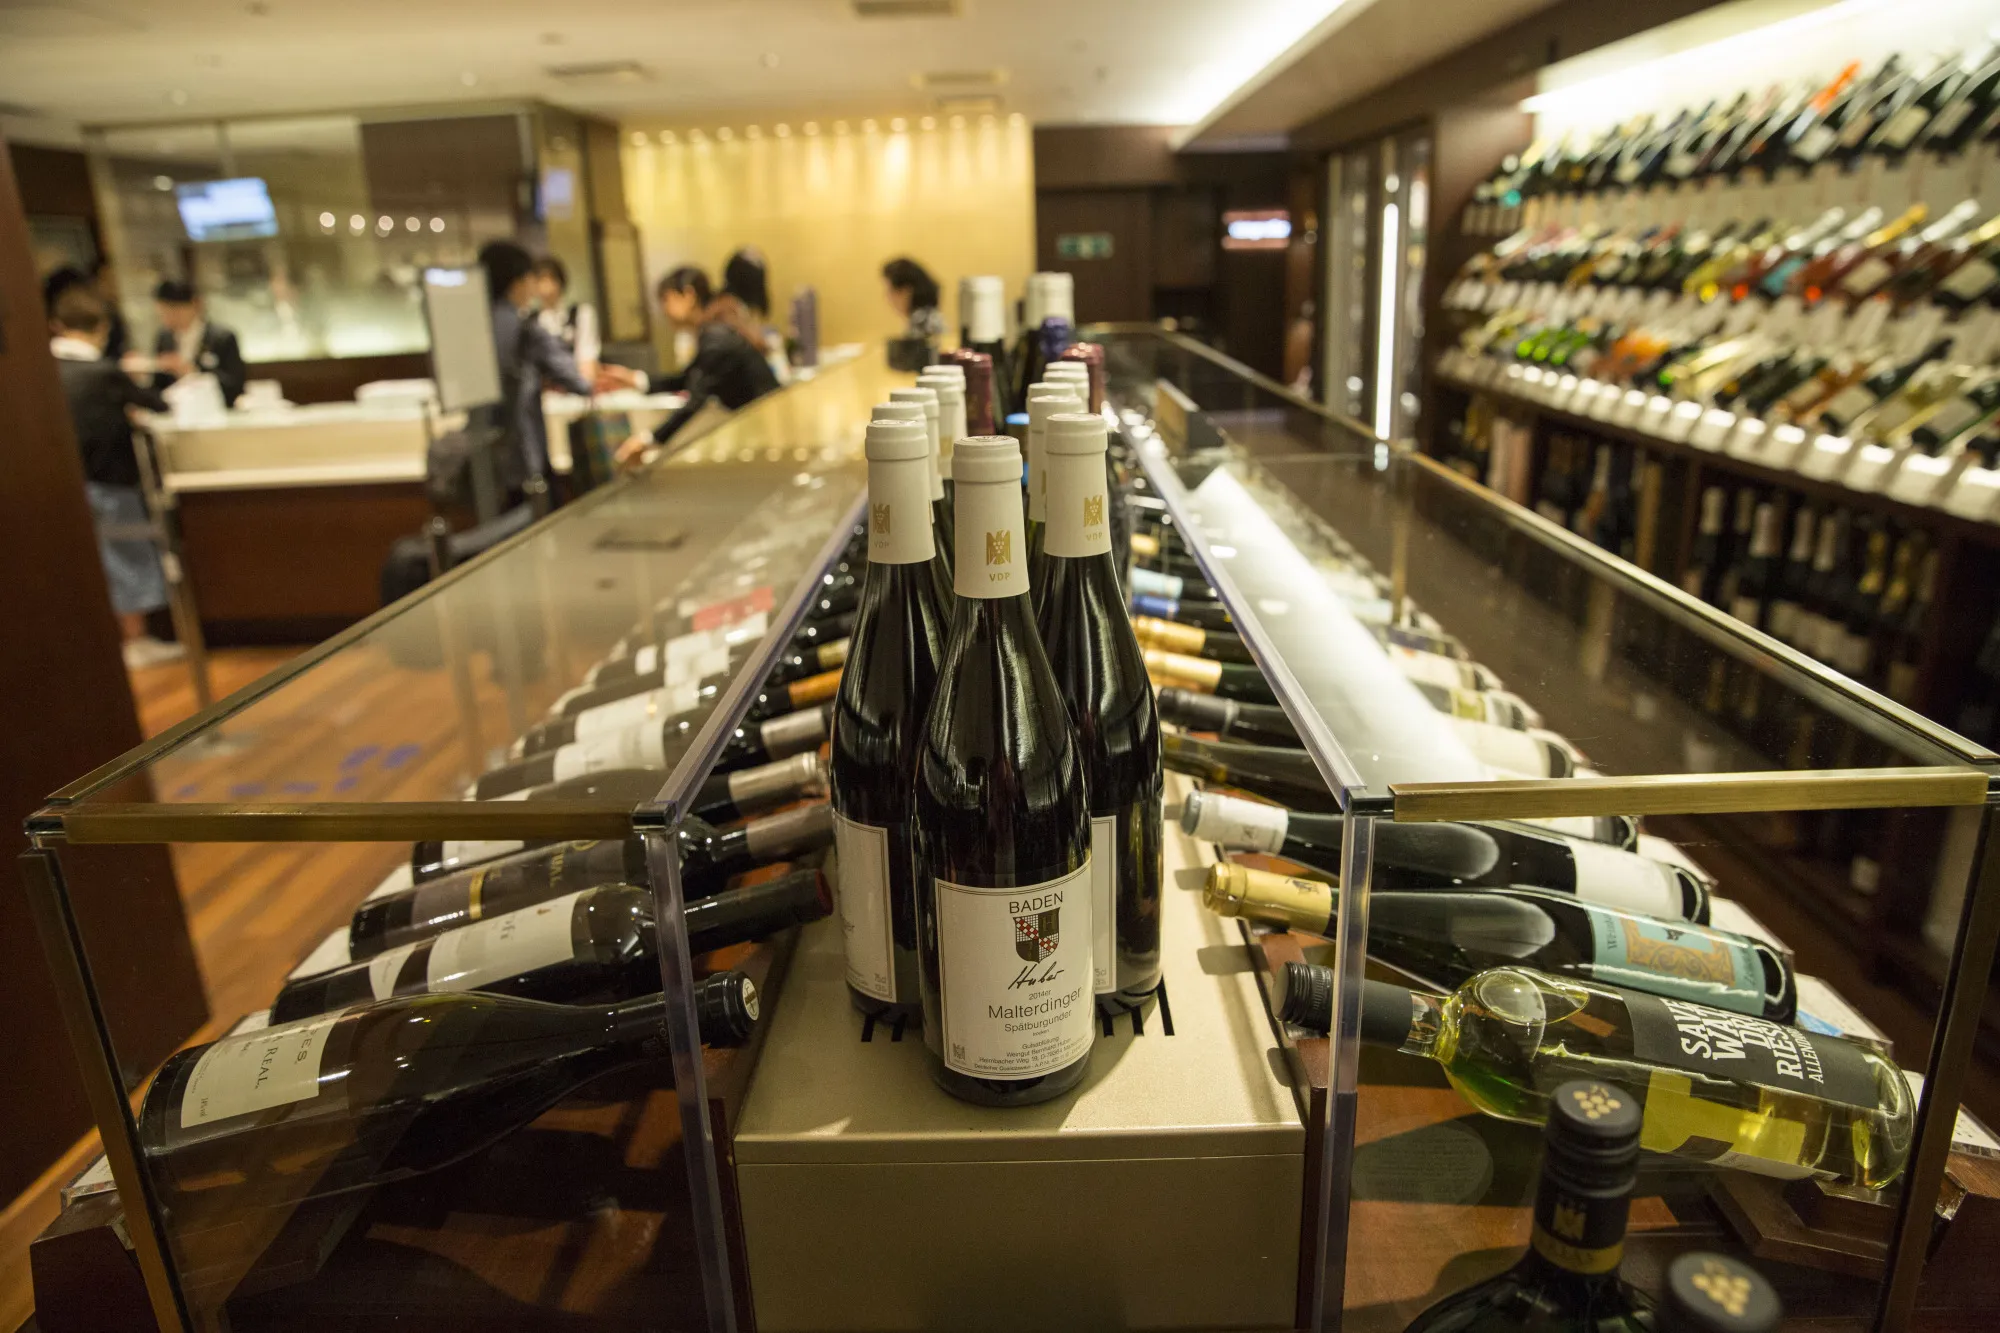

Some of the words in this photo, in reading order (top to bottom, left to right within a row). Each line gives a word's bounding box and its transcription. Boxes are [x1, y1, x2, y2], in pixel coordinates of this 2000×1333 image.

[1085, 532, 1103, 542] VDP
[989, 572, 1011, 582] VDP
[1009, 890, 1063, 914] BADEN
[988, 986, 1082, 1019] Malterdinger
[1028, 989, 1052, 1001] 2014er
[1004, 1009, 1072, 1034] Spätburgunder
[1661, 998, 1712, 1059] SAVE
